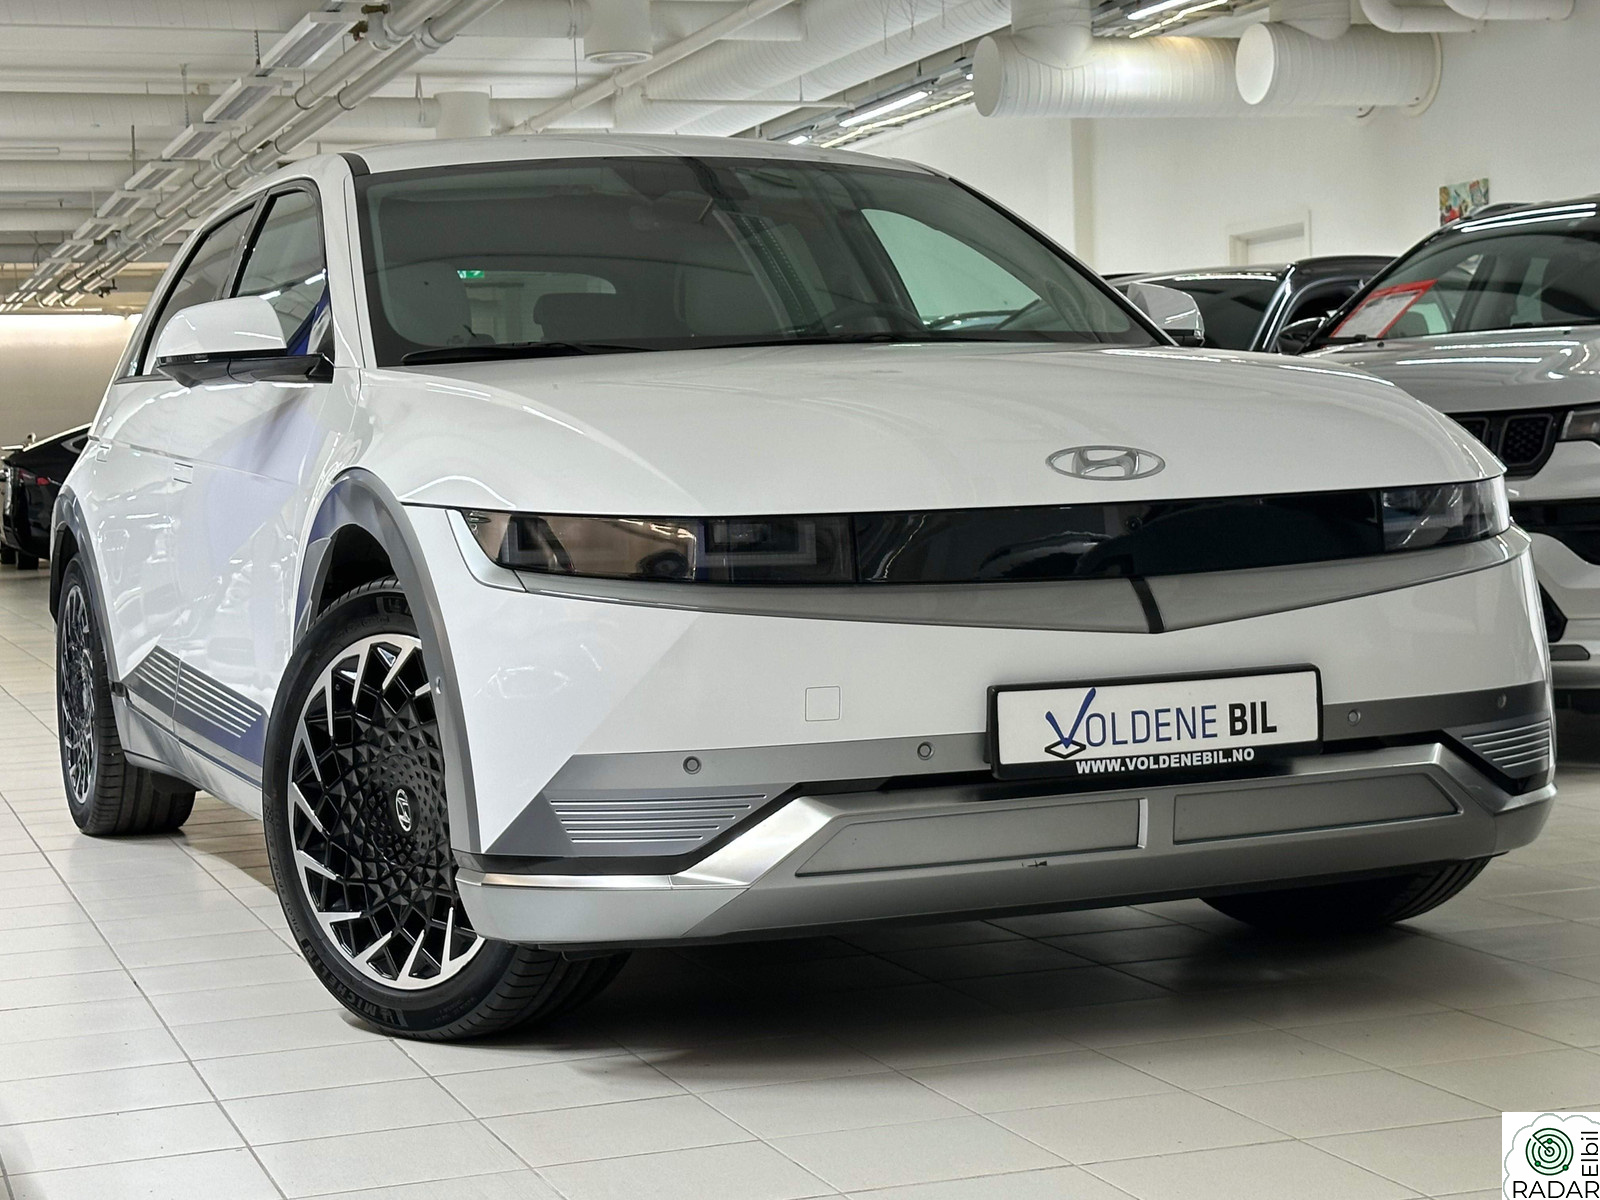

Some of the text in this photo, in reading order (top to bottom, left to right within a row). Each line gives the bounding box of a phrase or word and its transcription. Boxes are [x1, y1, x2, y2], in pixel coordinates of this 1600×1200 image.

[1045, 688, 1277, 748] VOLDENE BIL
[1076, 748, 1254, 774] WWW.VOLDENEBIL.NO
[304, 945, 377, 1017] MICHELIN
